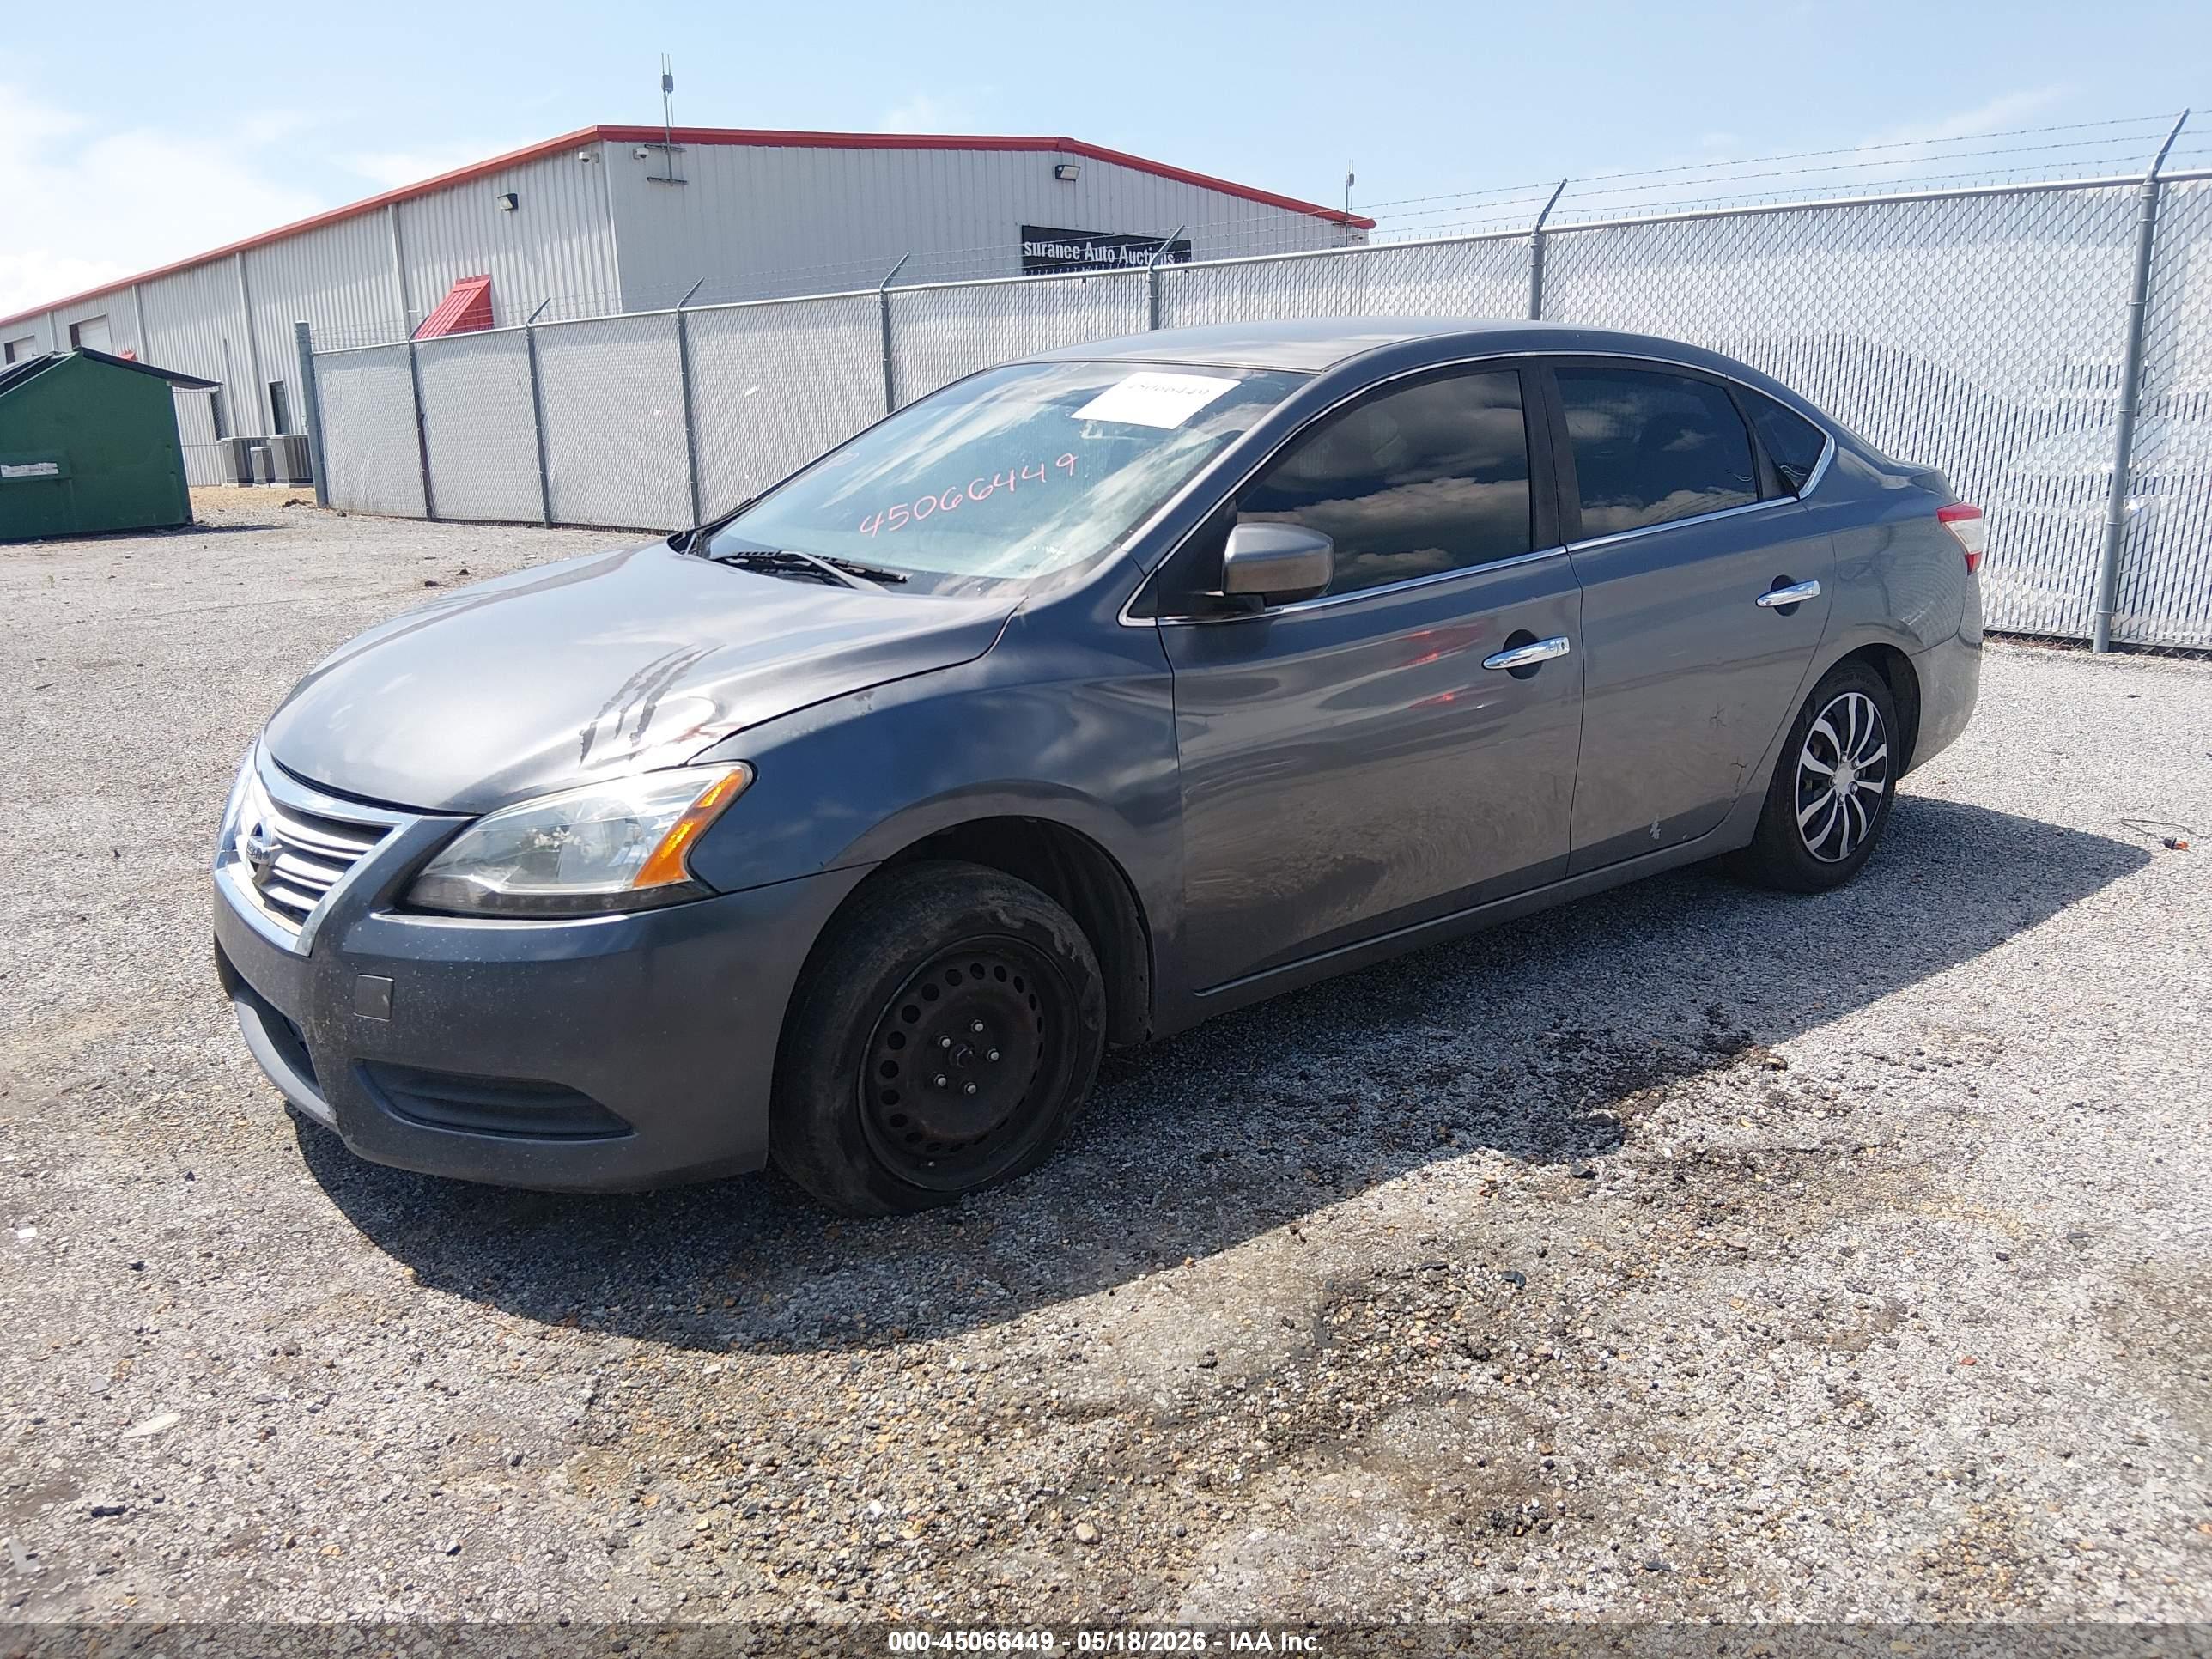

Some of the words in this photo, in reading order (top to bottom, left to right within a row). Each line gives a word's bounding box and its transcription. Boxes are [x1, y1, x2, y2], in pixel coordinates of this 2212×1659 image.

[1024, 241, 1080, 260] surance
[1085, 241, 1115, 263] Auto
[1119, 245, 1175, 267] Auctins
[860, 453, 1079, 538] 45066449
